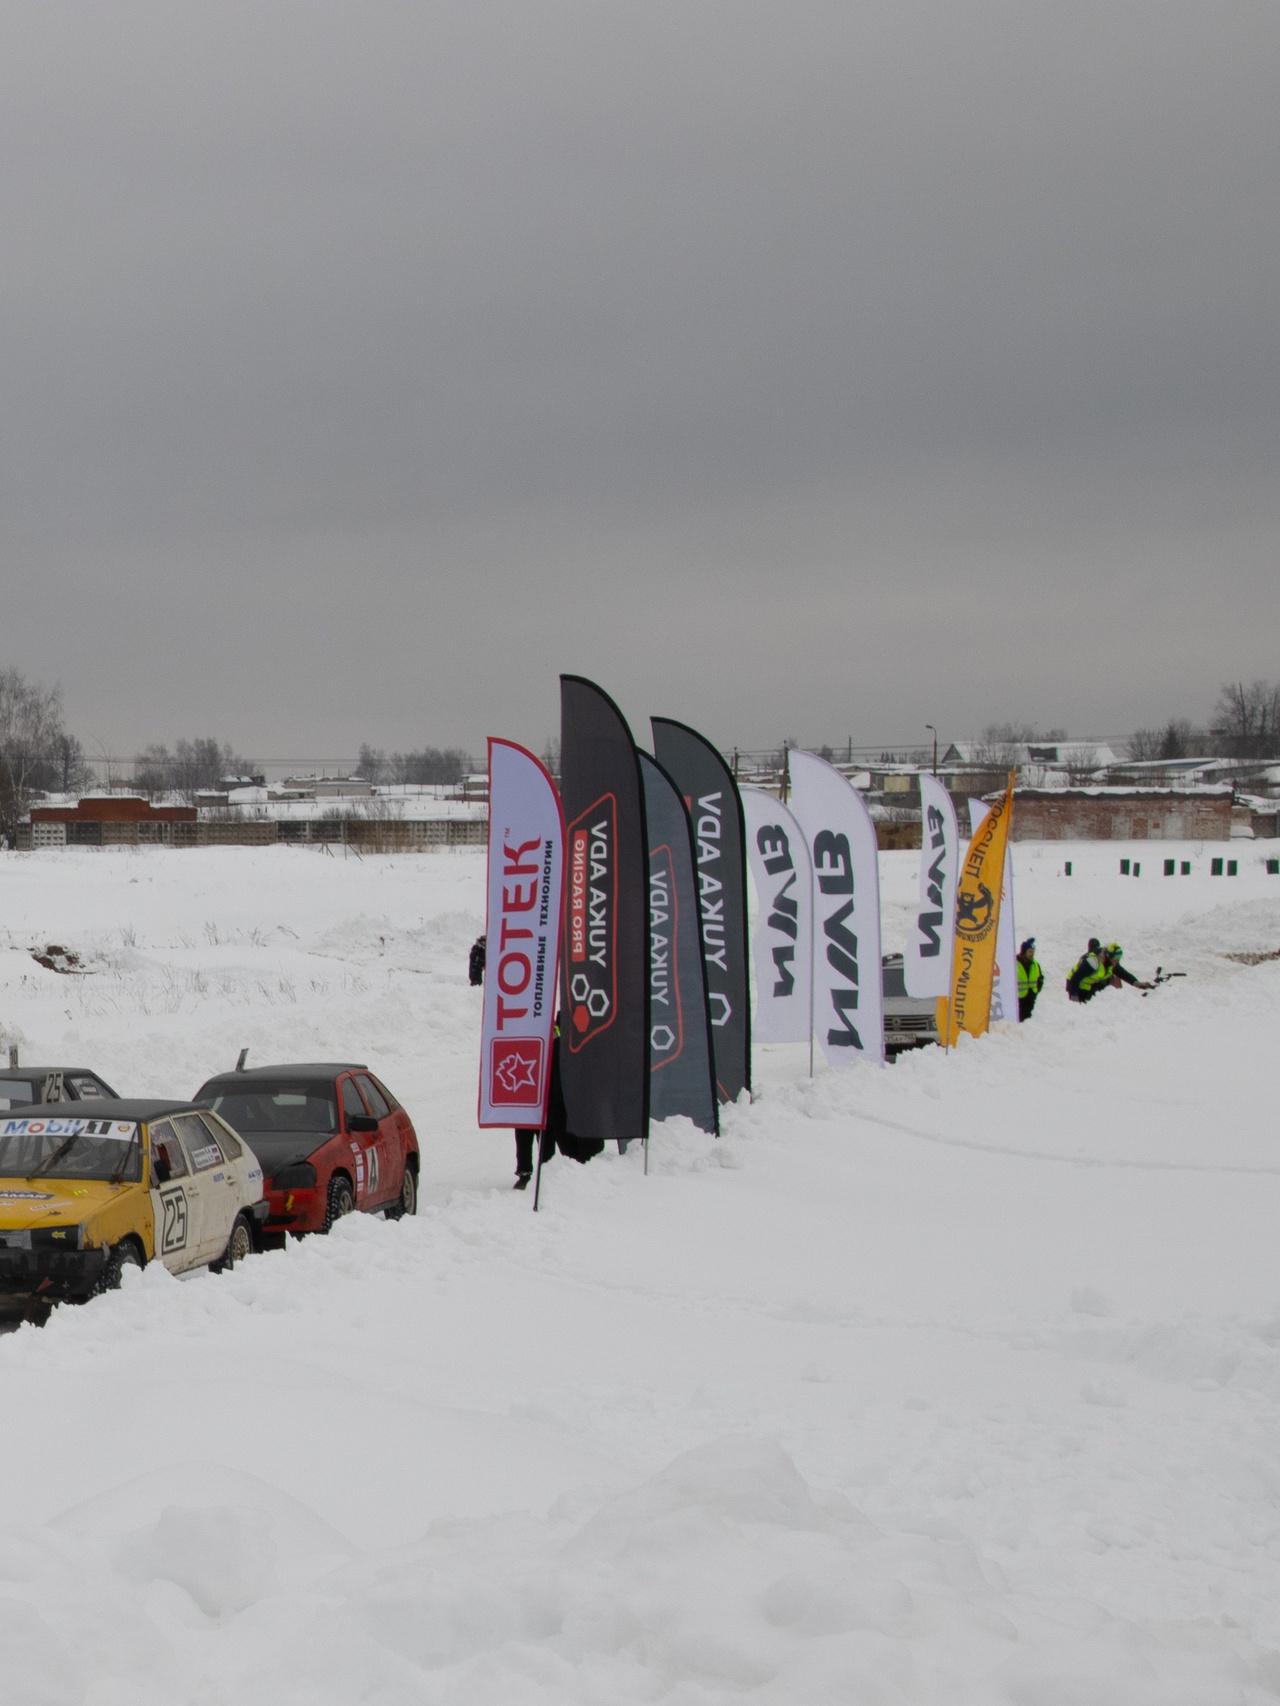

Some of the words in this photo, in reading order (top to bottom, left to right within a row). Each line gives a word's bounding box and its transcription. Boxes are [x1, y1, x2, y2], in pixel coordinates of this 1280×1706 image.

[539, 840, 553, 927] ТЕХНОЛОГИИ
[533, 935, 547, 1018] ТОПЛИВНЫЕ
[46, 1073, 62, 1103] 25
[4, 1120, 81, 1135] Mobil
[165, 1195, 186, 1247] 25
